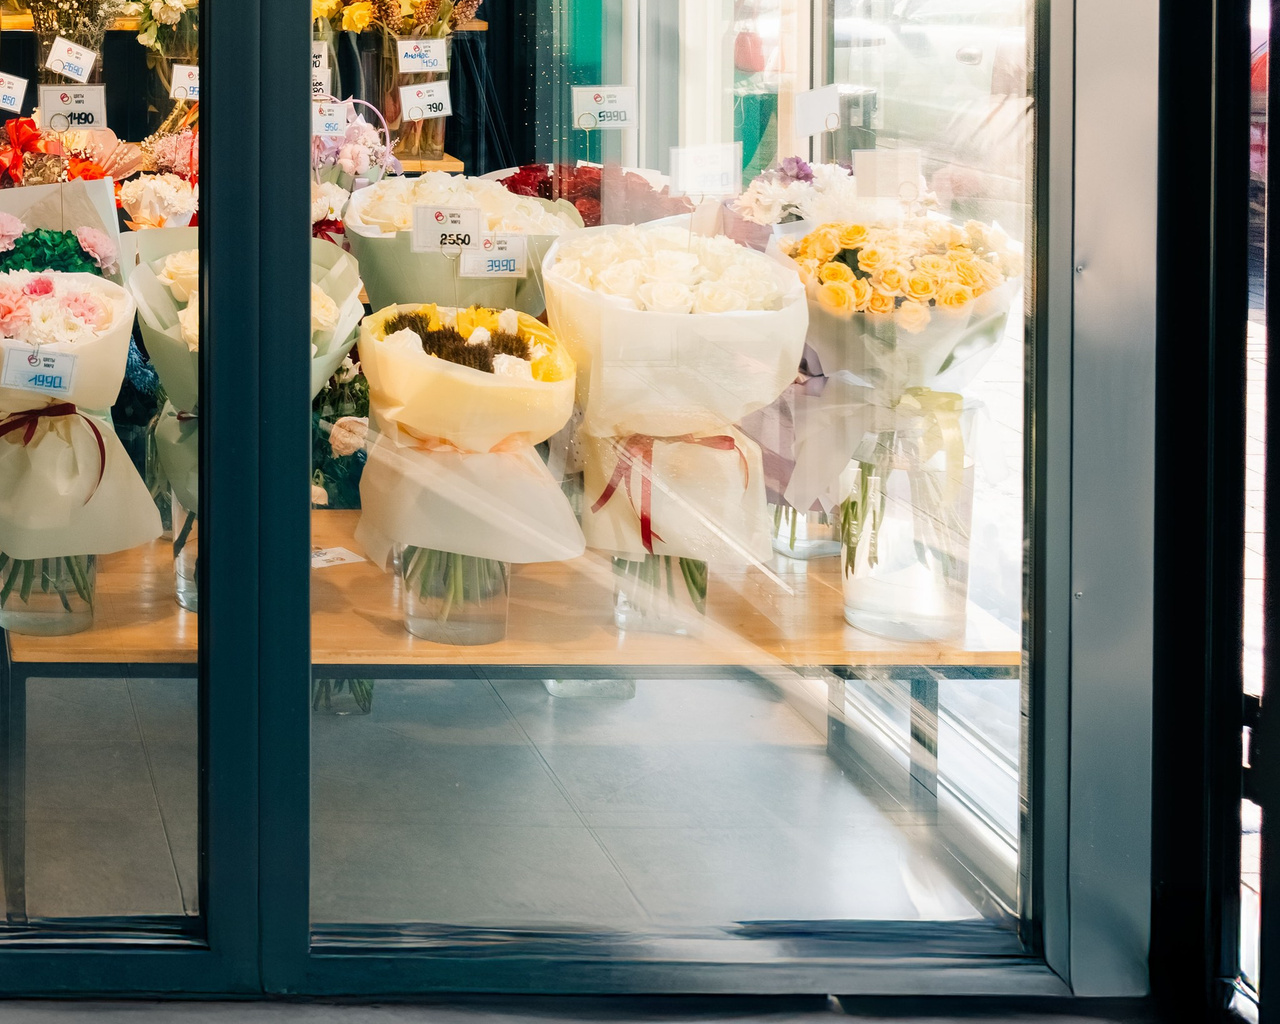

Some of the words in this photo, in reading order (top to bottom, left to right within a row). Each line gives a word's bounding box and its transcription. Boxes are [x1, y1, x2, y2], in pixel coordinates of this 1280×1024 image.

[422, 59, 438, 68] 450
[67, 112, 94, 124] 1490
[599, 110, 627, 122] 5990
[487, 259, 516, 272] 3990
[28, 374, 62, 388] 1990
